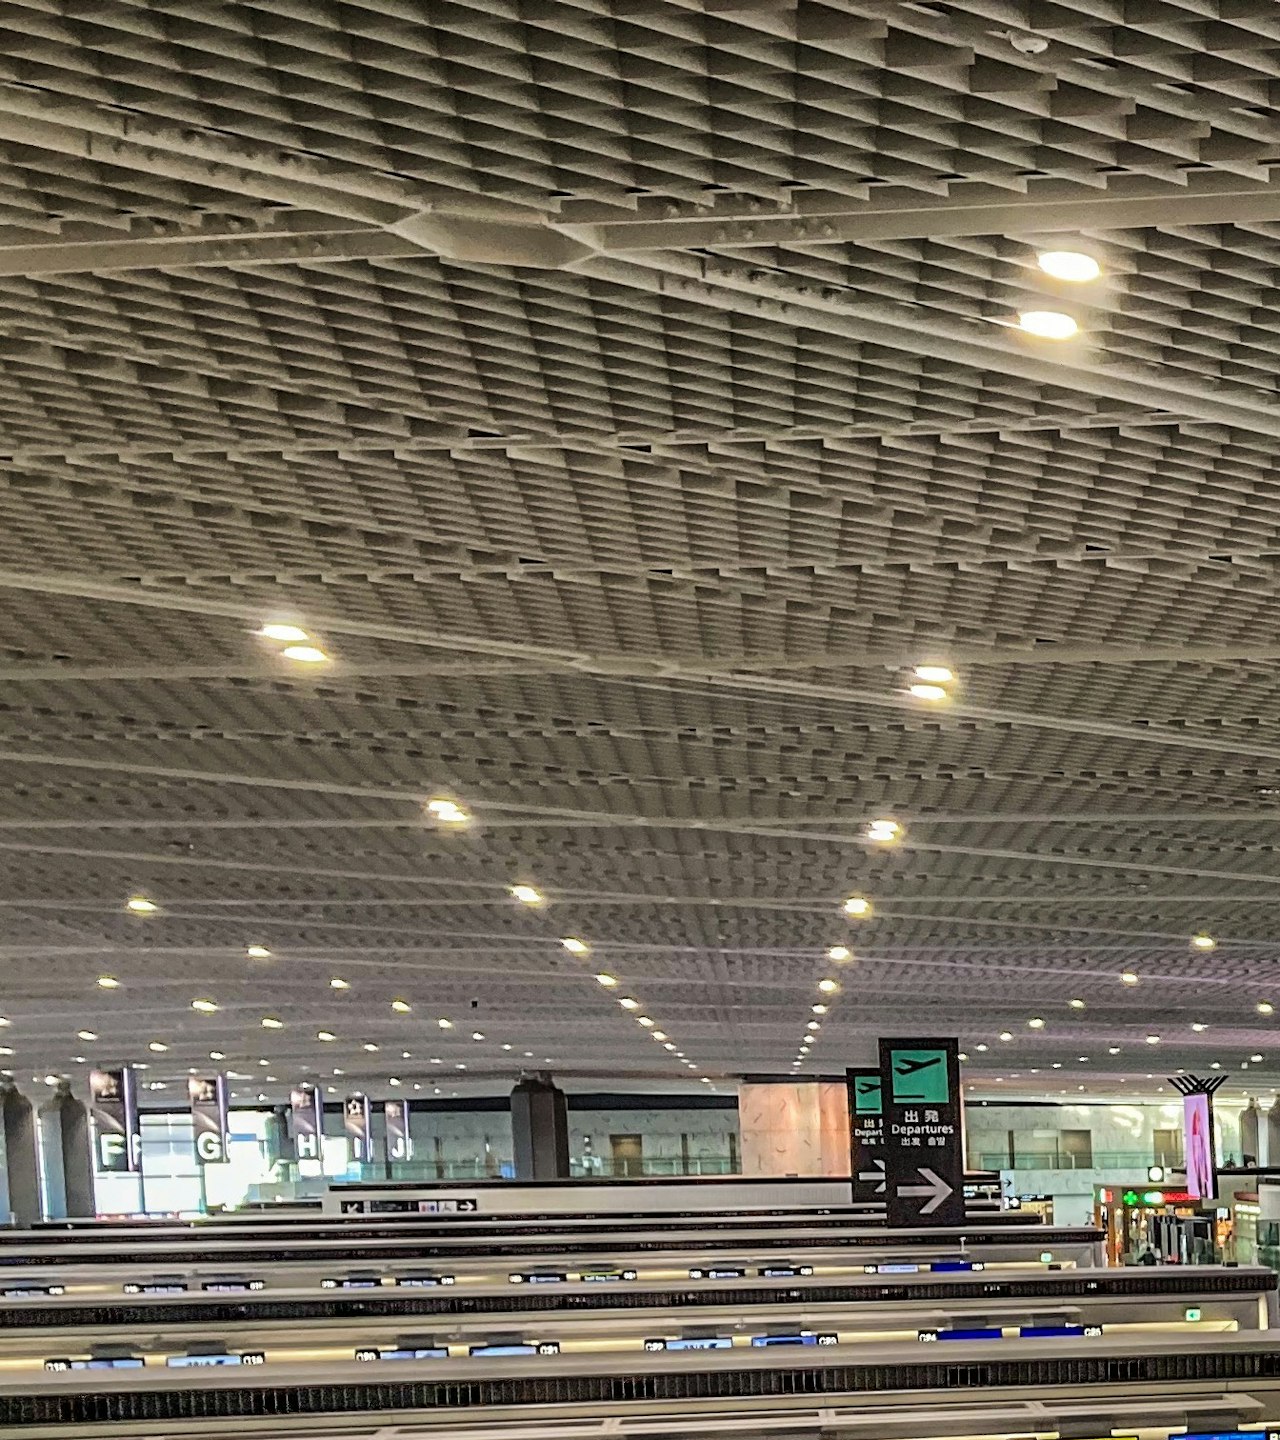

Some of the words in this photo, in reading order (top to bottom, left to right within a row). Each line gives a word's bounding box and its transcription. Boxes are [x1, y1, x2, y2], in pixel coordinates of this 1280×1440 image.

[905, 1110, 939, 1123] 出発
[855, 1129, 883, 1137] Depart
[891, 1124, 954, 1135] Departures
[100, 1134, 126, 1166] F
[197, 1134, 221, 1160] G
[299, 1134, 316, 1157] H
[392, 1137, 404, 1158] J
